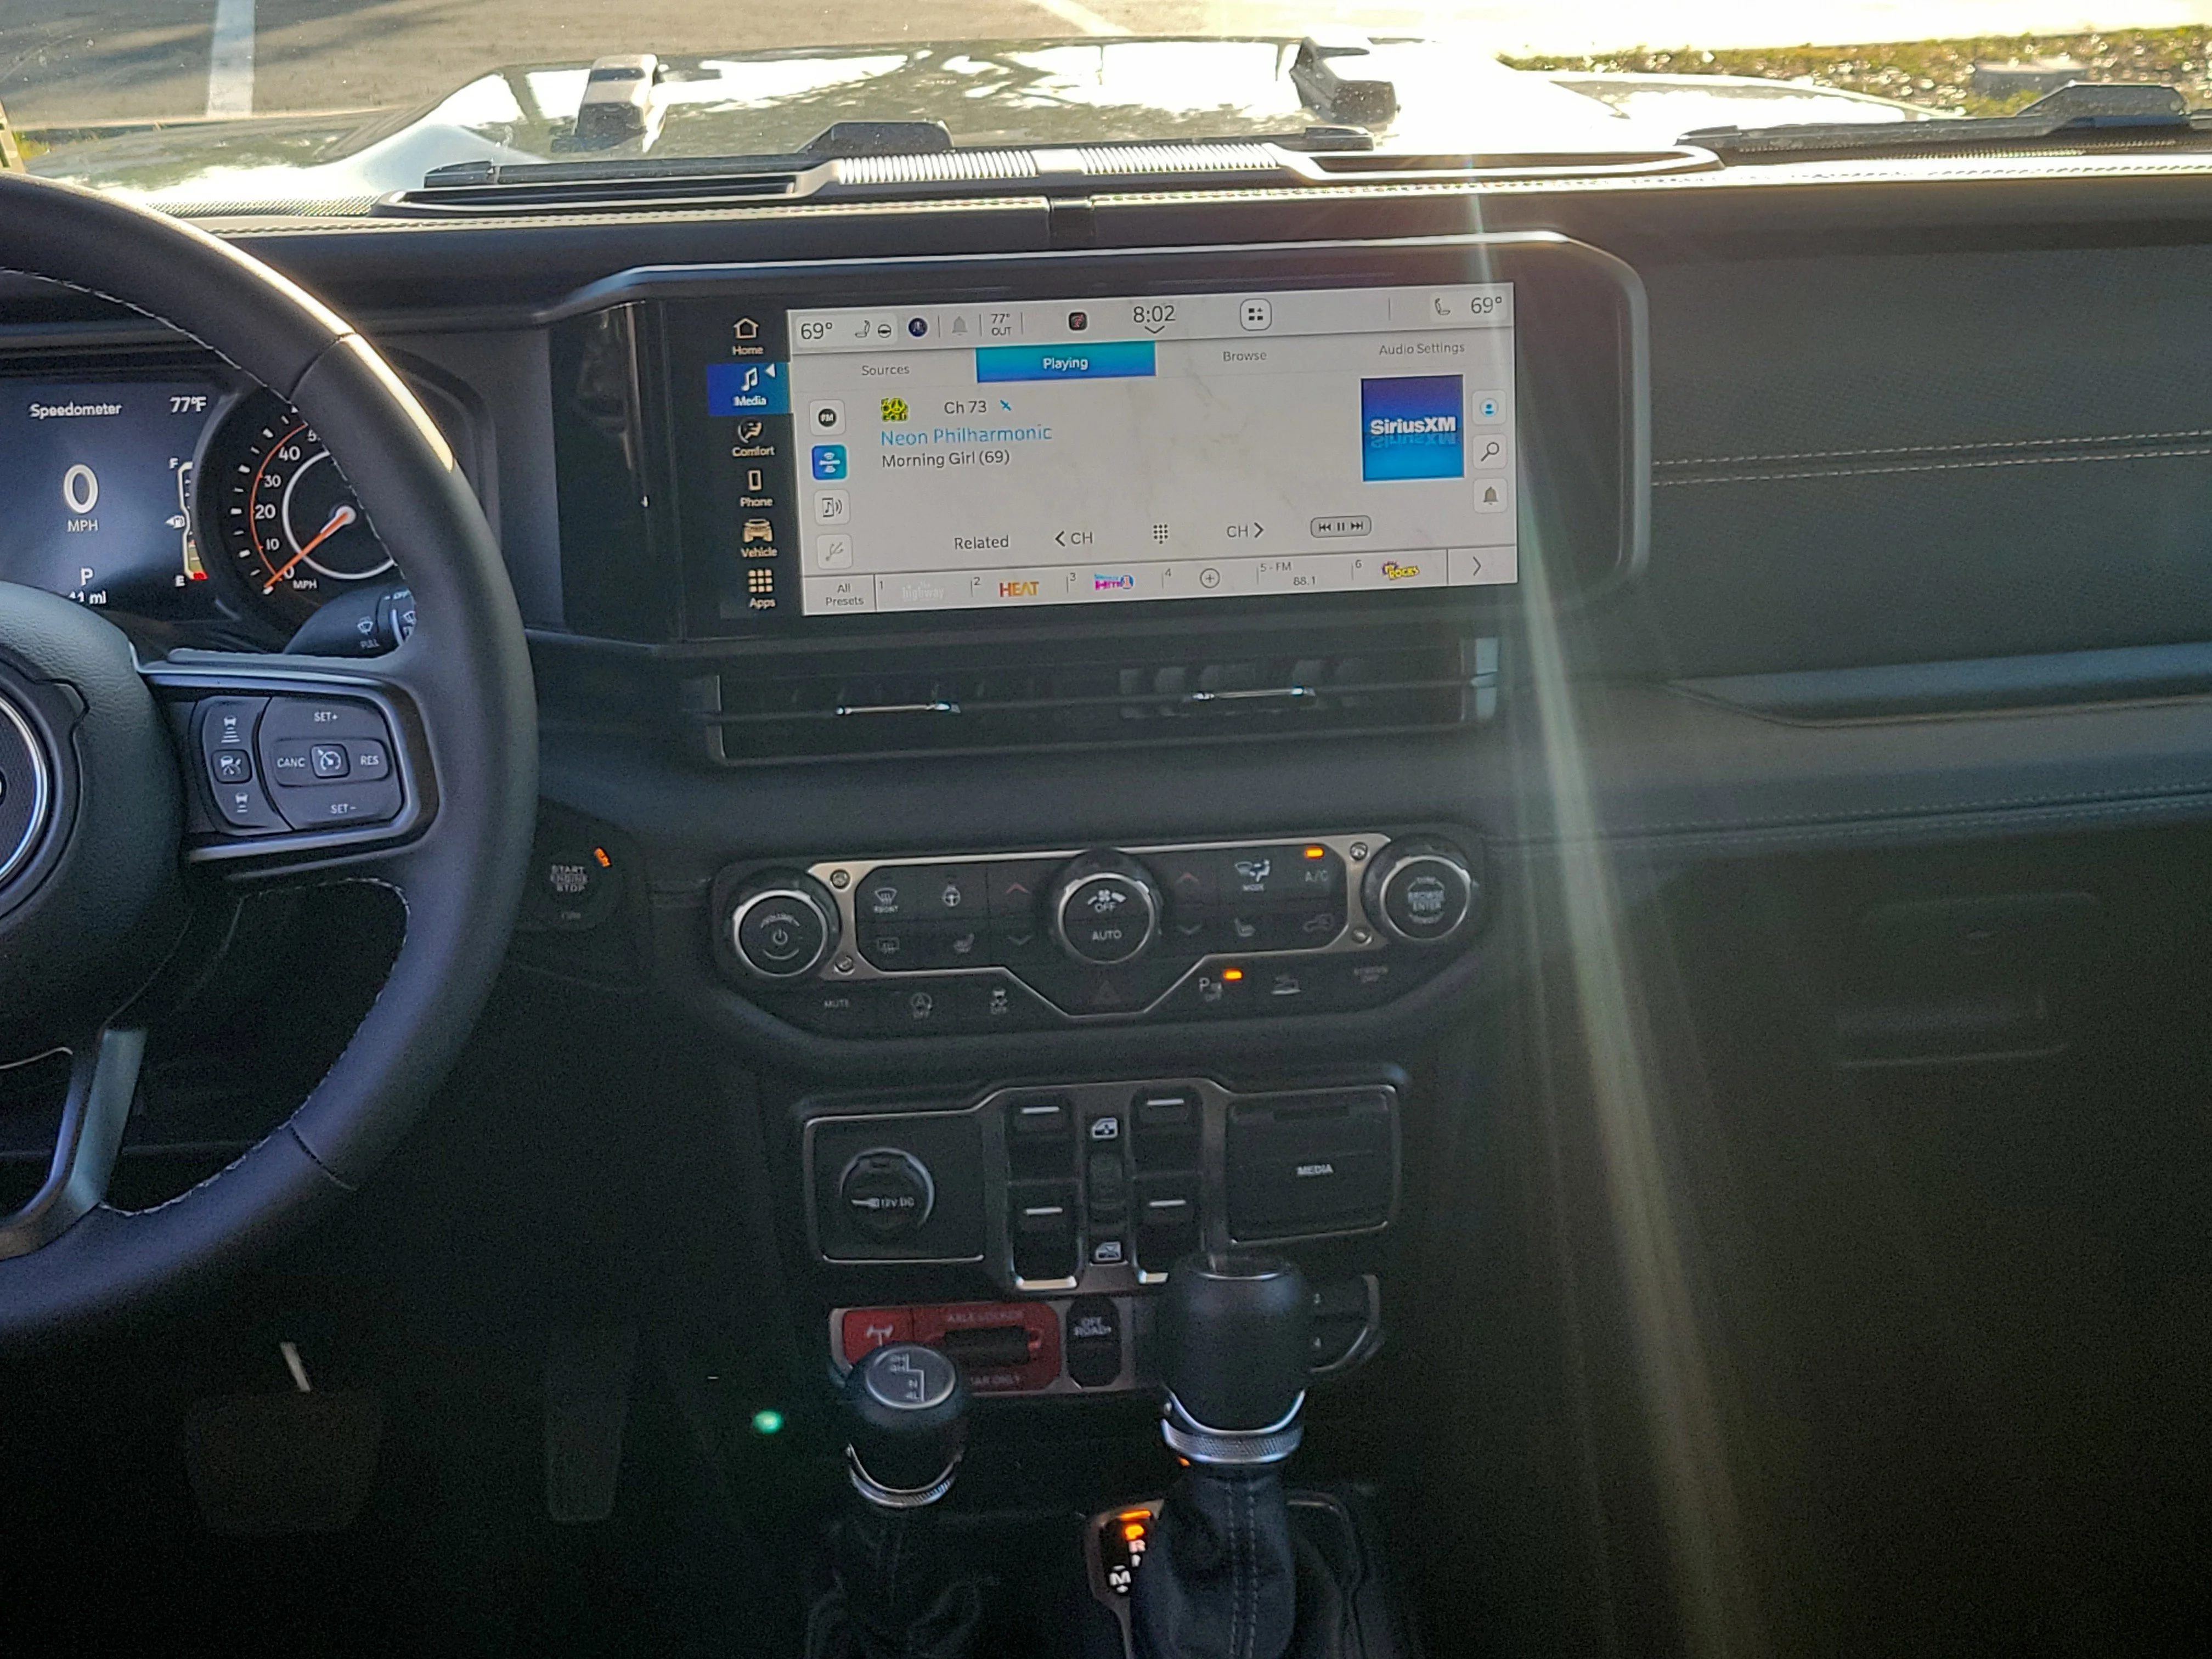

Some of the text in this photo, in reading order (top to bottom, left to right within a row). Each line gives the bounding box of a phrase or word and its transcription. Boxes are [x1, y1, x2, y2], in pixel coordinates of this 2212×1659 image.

[1471, 297, 1502, 314] 69°
[991, 313, 1011, 324] 77°
[1133, 305, 1176, 323] 8:02
[800, 322, 833, 340] 69°
[991, 326, 1012, 336] OUT
[732, 346, 763, 356] Home
[1379, 342, 1465, 356] Audio Settings
[1223, 350, 1267, 362] Browse
[861, 364, 910, 376] Sources
[1043, 357, 1088, 371] Playing
[170, 396, 207, 413] 77°F
[733, 396, 767, 407] Media
[944, 400, 987, 414] Ch 73
[30, 402, 122, 420] Speedometer
[1370, 417, 1456, 435] SiriusXM
[881, 425, 1053, 446] Neon Philharmonic
[279, 447, 301, 462] 40
[732, 445, 775, 458] Comfort
[170, 459, 178, 469] F
[882, 450, 1011, 471] Morning Girl (69)
[263, 475, 281, 488] 30
[63, 464, 98, 514] 0
[740, 496, 773, 507] Phone
[255, 505, 276, 520] 20
[67, 519, 98, 532] MPH
[1227, 525, 1248, 538] CH
[953, 536, 1009, 550] Related
[1071, 532, 1093, 545] CH
[266, 539, 280, 551] 10
[741, 547, 777, 557] Vehicle
[1276, 562, 1291, 571] FM
[1356, 560, 1362, 568] 6
[81, 567, 93, 586] P
[284, 567, 295, 580] 0
[1070, 573, 1076, 582] 3
[175, 575, 185, 587] E
[293, 579, 317, 590] MPH
[1293, 576, 1316, 585] 88.1
[837, 583, 850, 593] All
[880, 580, 944, 601] 1 highway
[999, 582, 1039, 597] HEAT
[749, 596, 776, 608] Apps
[826, 596, 864, 606] Presets
[360, 639, 380, 649] PULL
[277, 758, 305, 768] CANC
[360, 755, 379, 765] RES
[1305, 870, 1328, 882] A/C
[1094, 902, 1117, 913] OFF
[1092, 930, 1122, 940] AUTO
[825, 999, 849, 1008] MUTE
[1297, 1164, 1334, 1175] MEDIA
[1109, 1570, 1131, 1586] M
